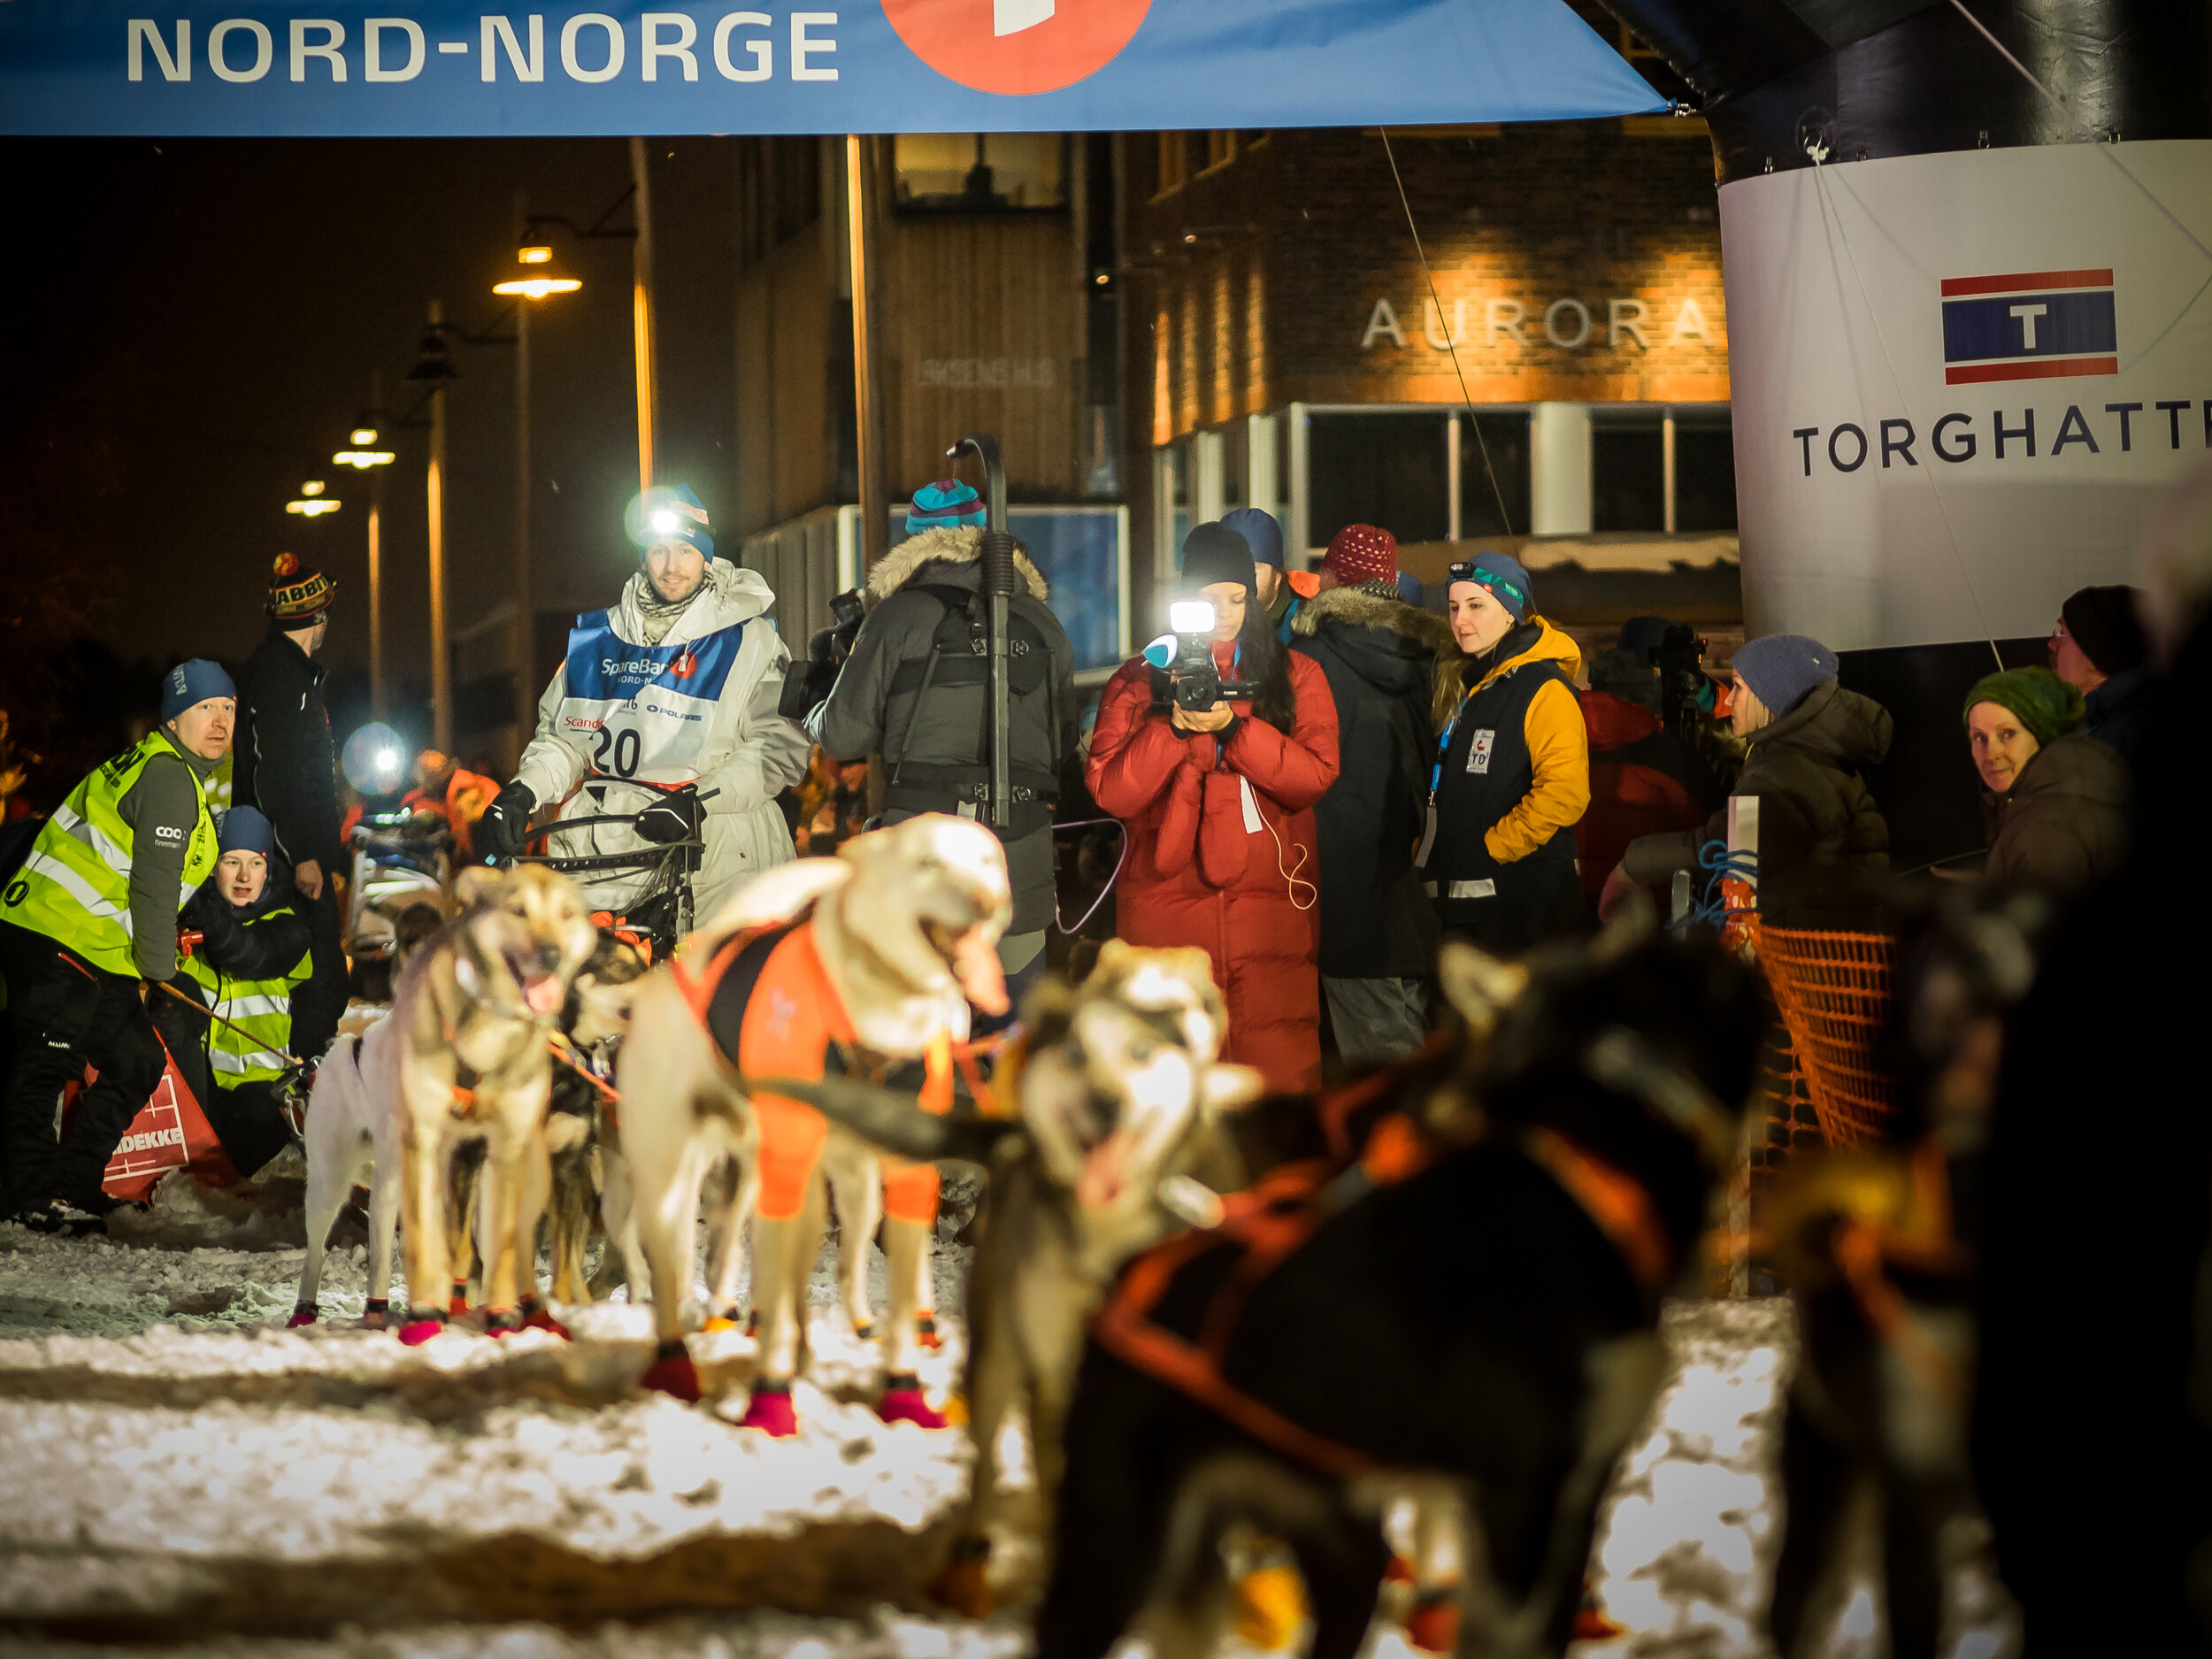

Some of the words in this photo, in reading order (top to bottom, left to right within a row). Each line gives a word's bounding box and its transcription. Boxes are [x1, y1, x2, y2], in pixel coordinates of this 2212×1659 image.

[127, 12, 840, 83] NORD-NORGE
[1361, 297, 1715, 351] AURORA
[2009, 303, 2047, 349] T
[659, 707, 703, 722] POLARIS
[588, 725, 641, 778] 20
